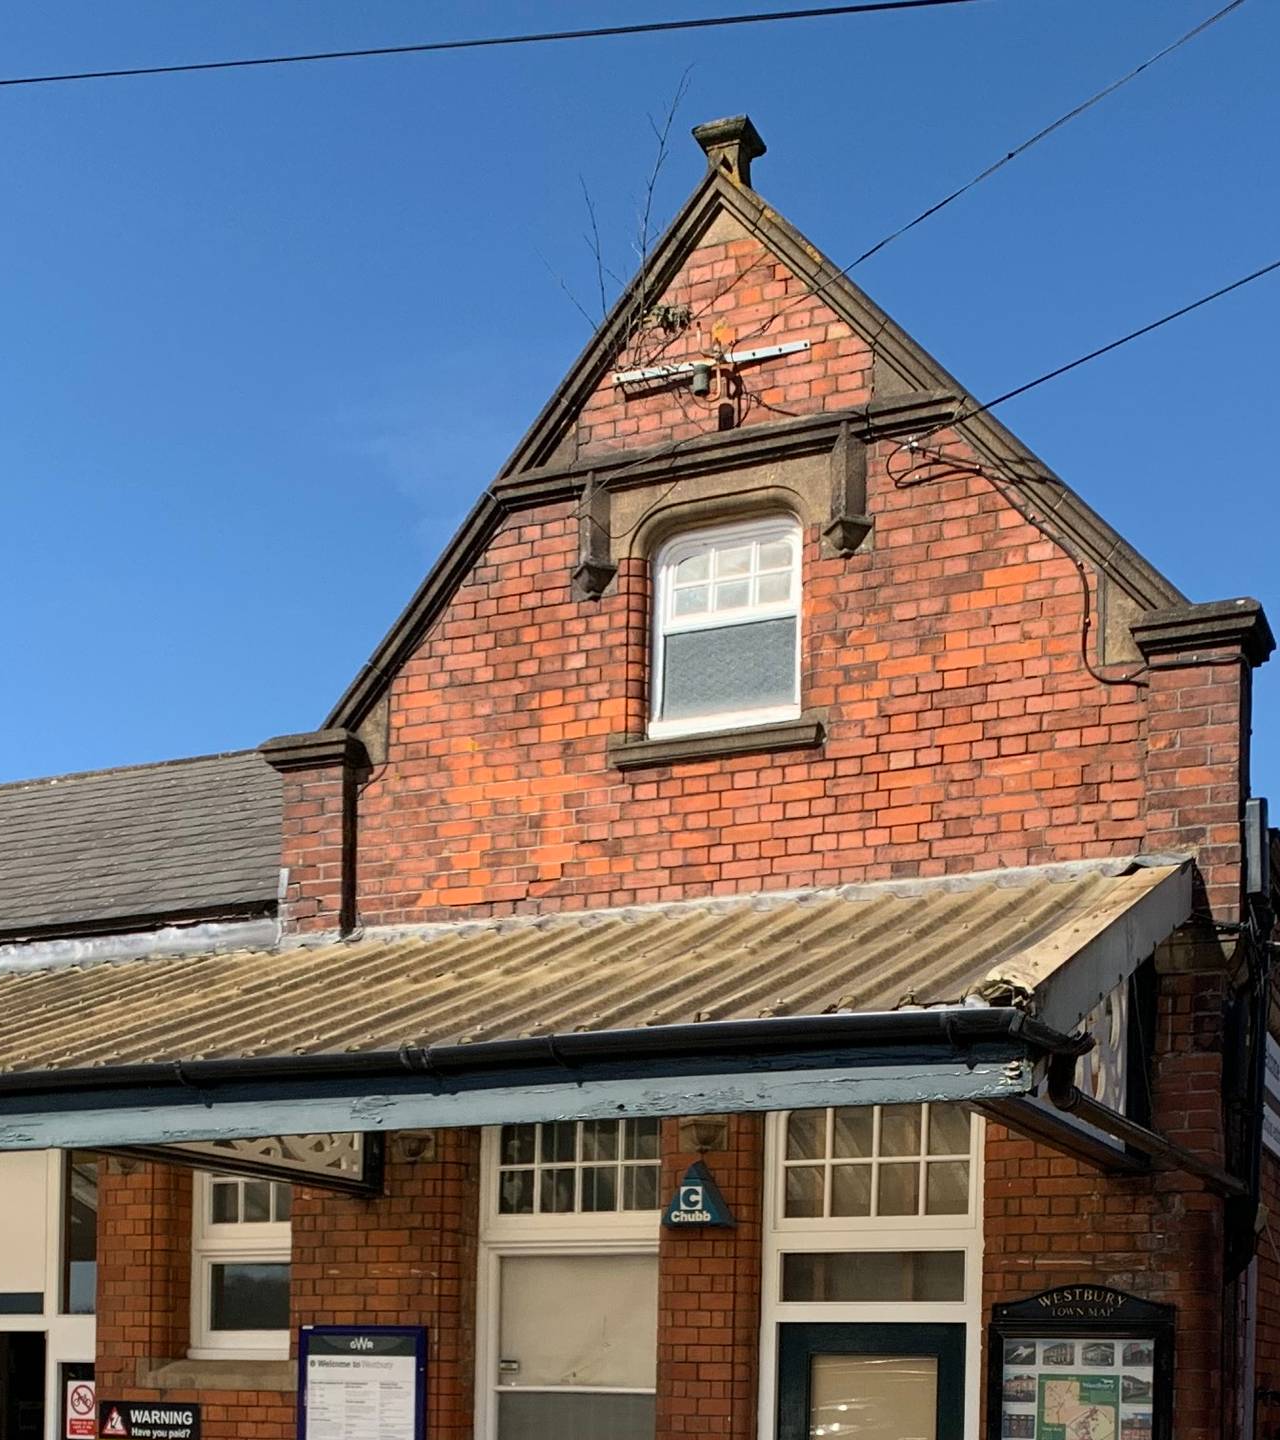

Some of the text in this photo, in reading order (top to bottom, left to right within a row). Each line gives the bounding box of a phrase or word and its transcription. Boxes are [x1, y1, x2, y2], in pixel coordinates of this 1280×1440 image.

[671, 1210, 711, 1222] Chubb
[1038, 1288, 1127, 1308] WESTBURY
[1052, 1307, 1114, 1317] TOWN MAP
[349, 1337, 374, 1350] GWR
[318, 1360, 351, 1368] Welcome
[130, 1410, 193, 1425] WARNING
[131, 1427, 191, 1439] Have you paid?
